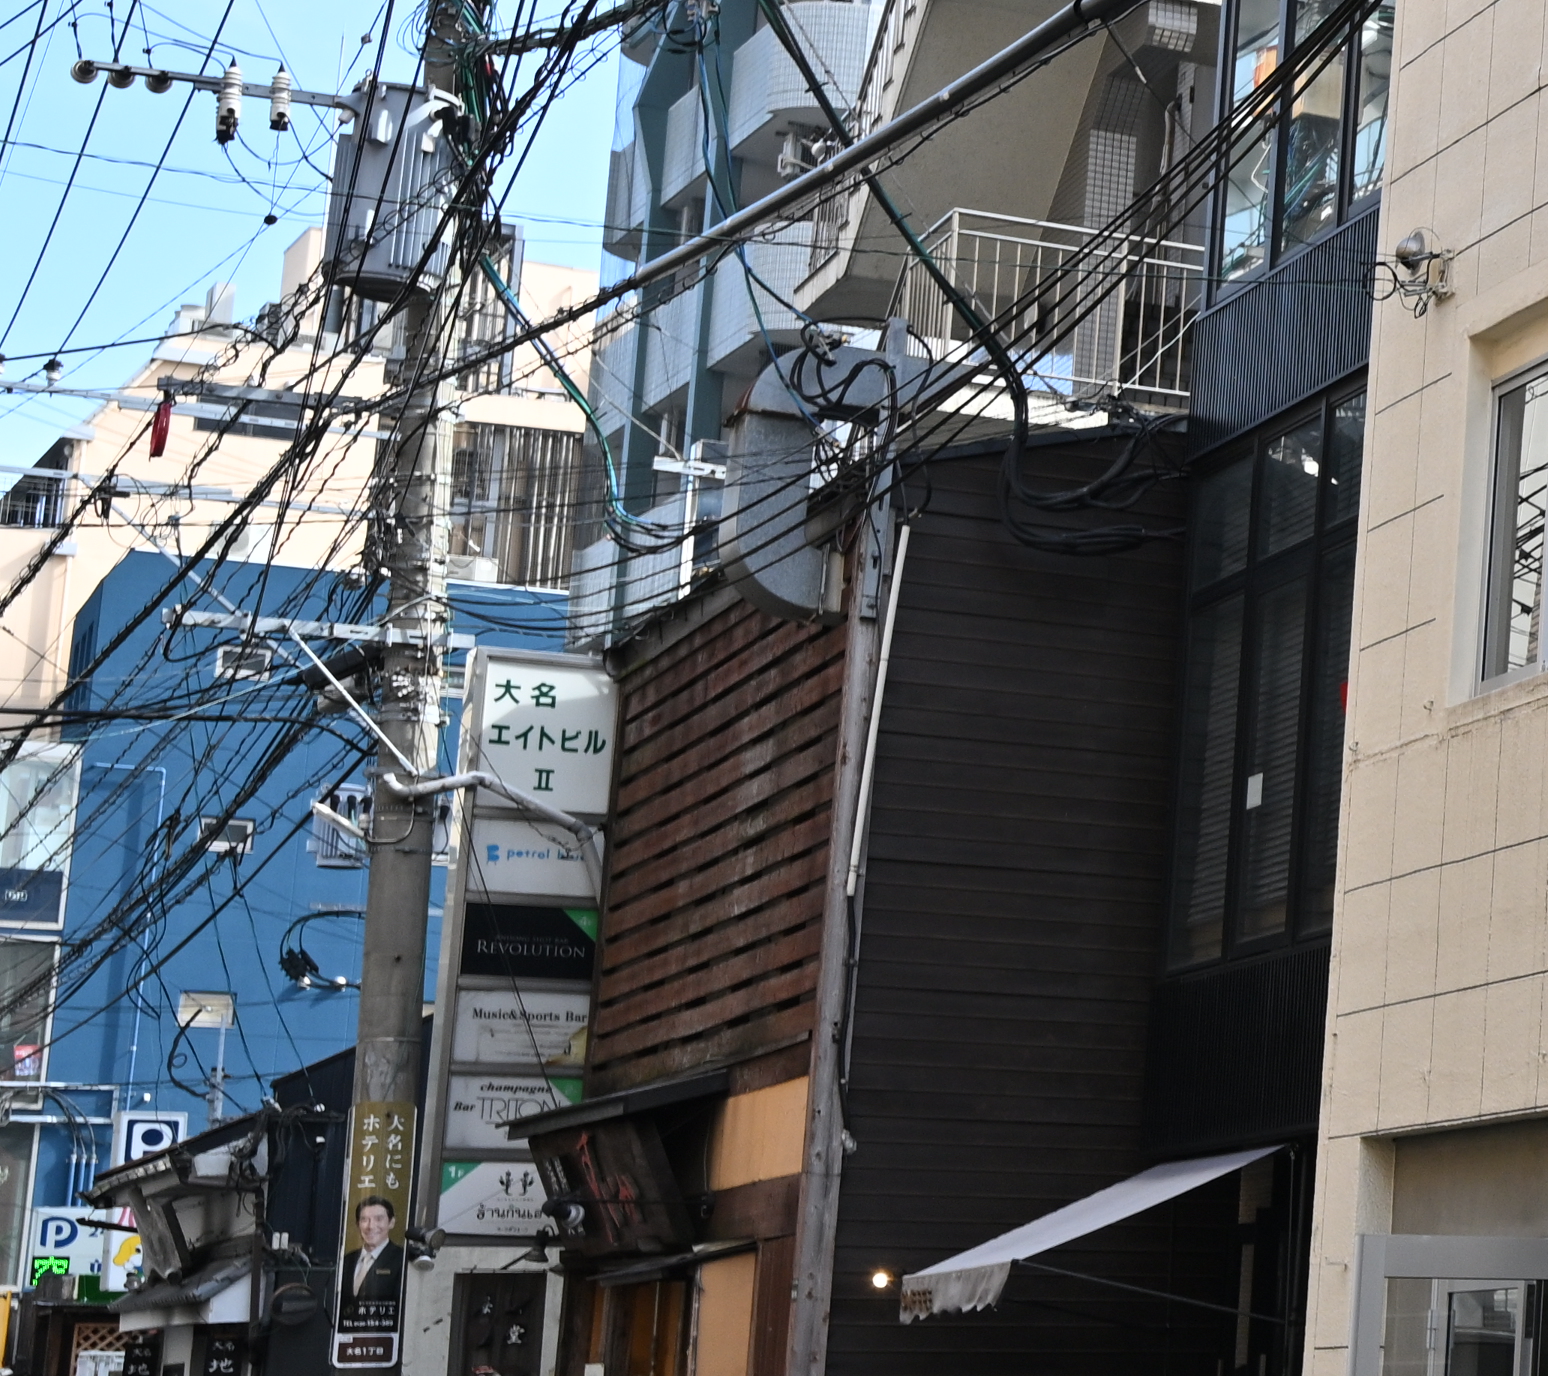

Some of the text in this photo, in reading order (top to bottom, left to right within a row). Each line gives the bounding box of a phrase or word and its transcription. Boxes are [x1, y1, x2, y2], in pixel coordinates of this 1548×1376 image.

[494, 679, 557, 709] 大名
[488, 723, 607, 755] エイトビル
[565, 1010, 588, 1023] Bar
[453, 1101, 476, 1112] Bar
[357, 1114, 380, 1190] ホテリエ
[386, 1114, 404, 1190] 大名にも
